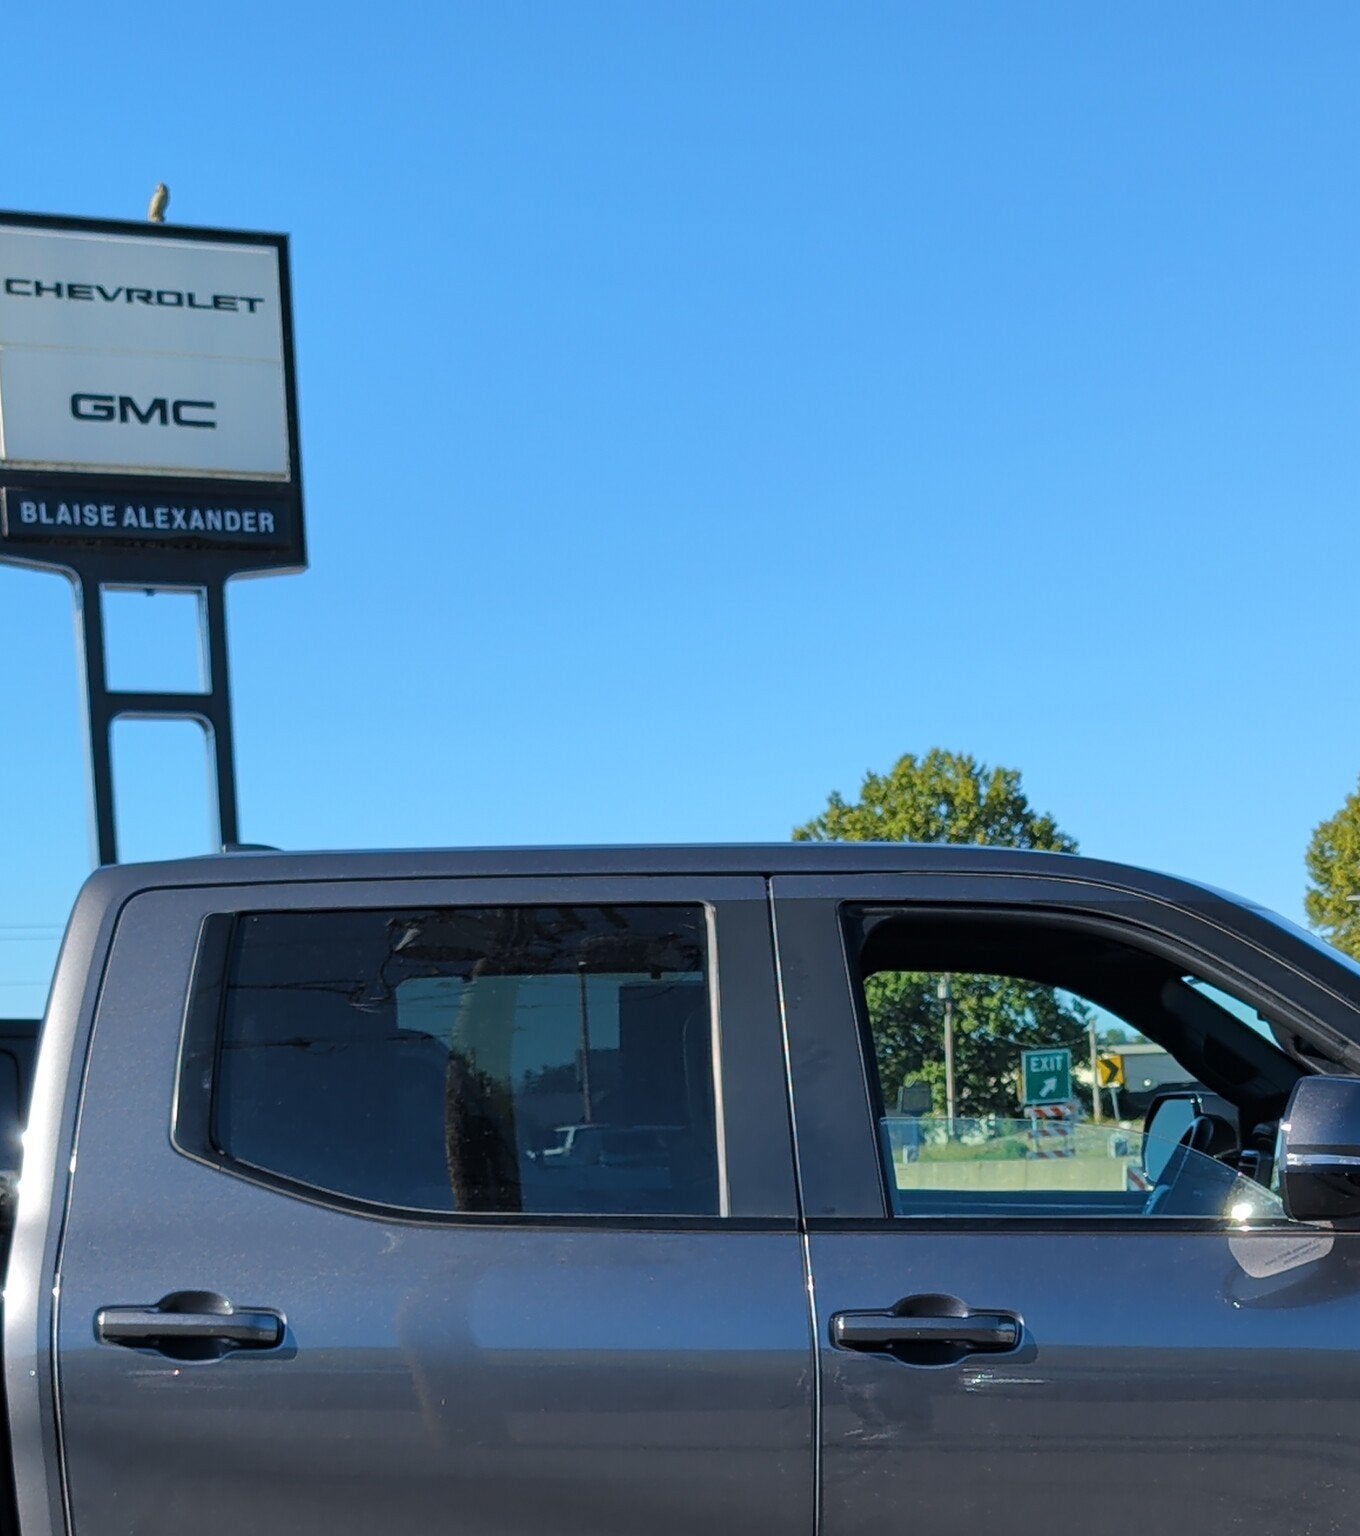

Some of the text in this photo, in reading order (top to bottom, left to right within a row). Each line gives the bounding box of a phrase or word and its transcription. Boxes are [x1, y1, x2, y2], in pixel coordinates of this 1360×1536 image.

[4, 277, 265, 314] CHEVROLET
[70, 392, 218, 430] GMC
[19, 500, 276, 534] BLAISE ALEXANDER
[1030, 1055, 1064, 1072] EXIT
